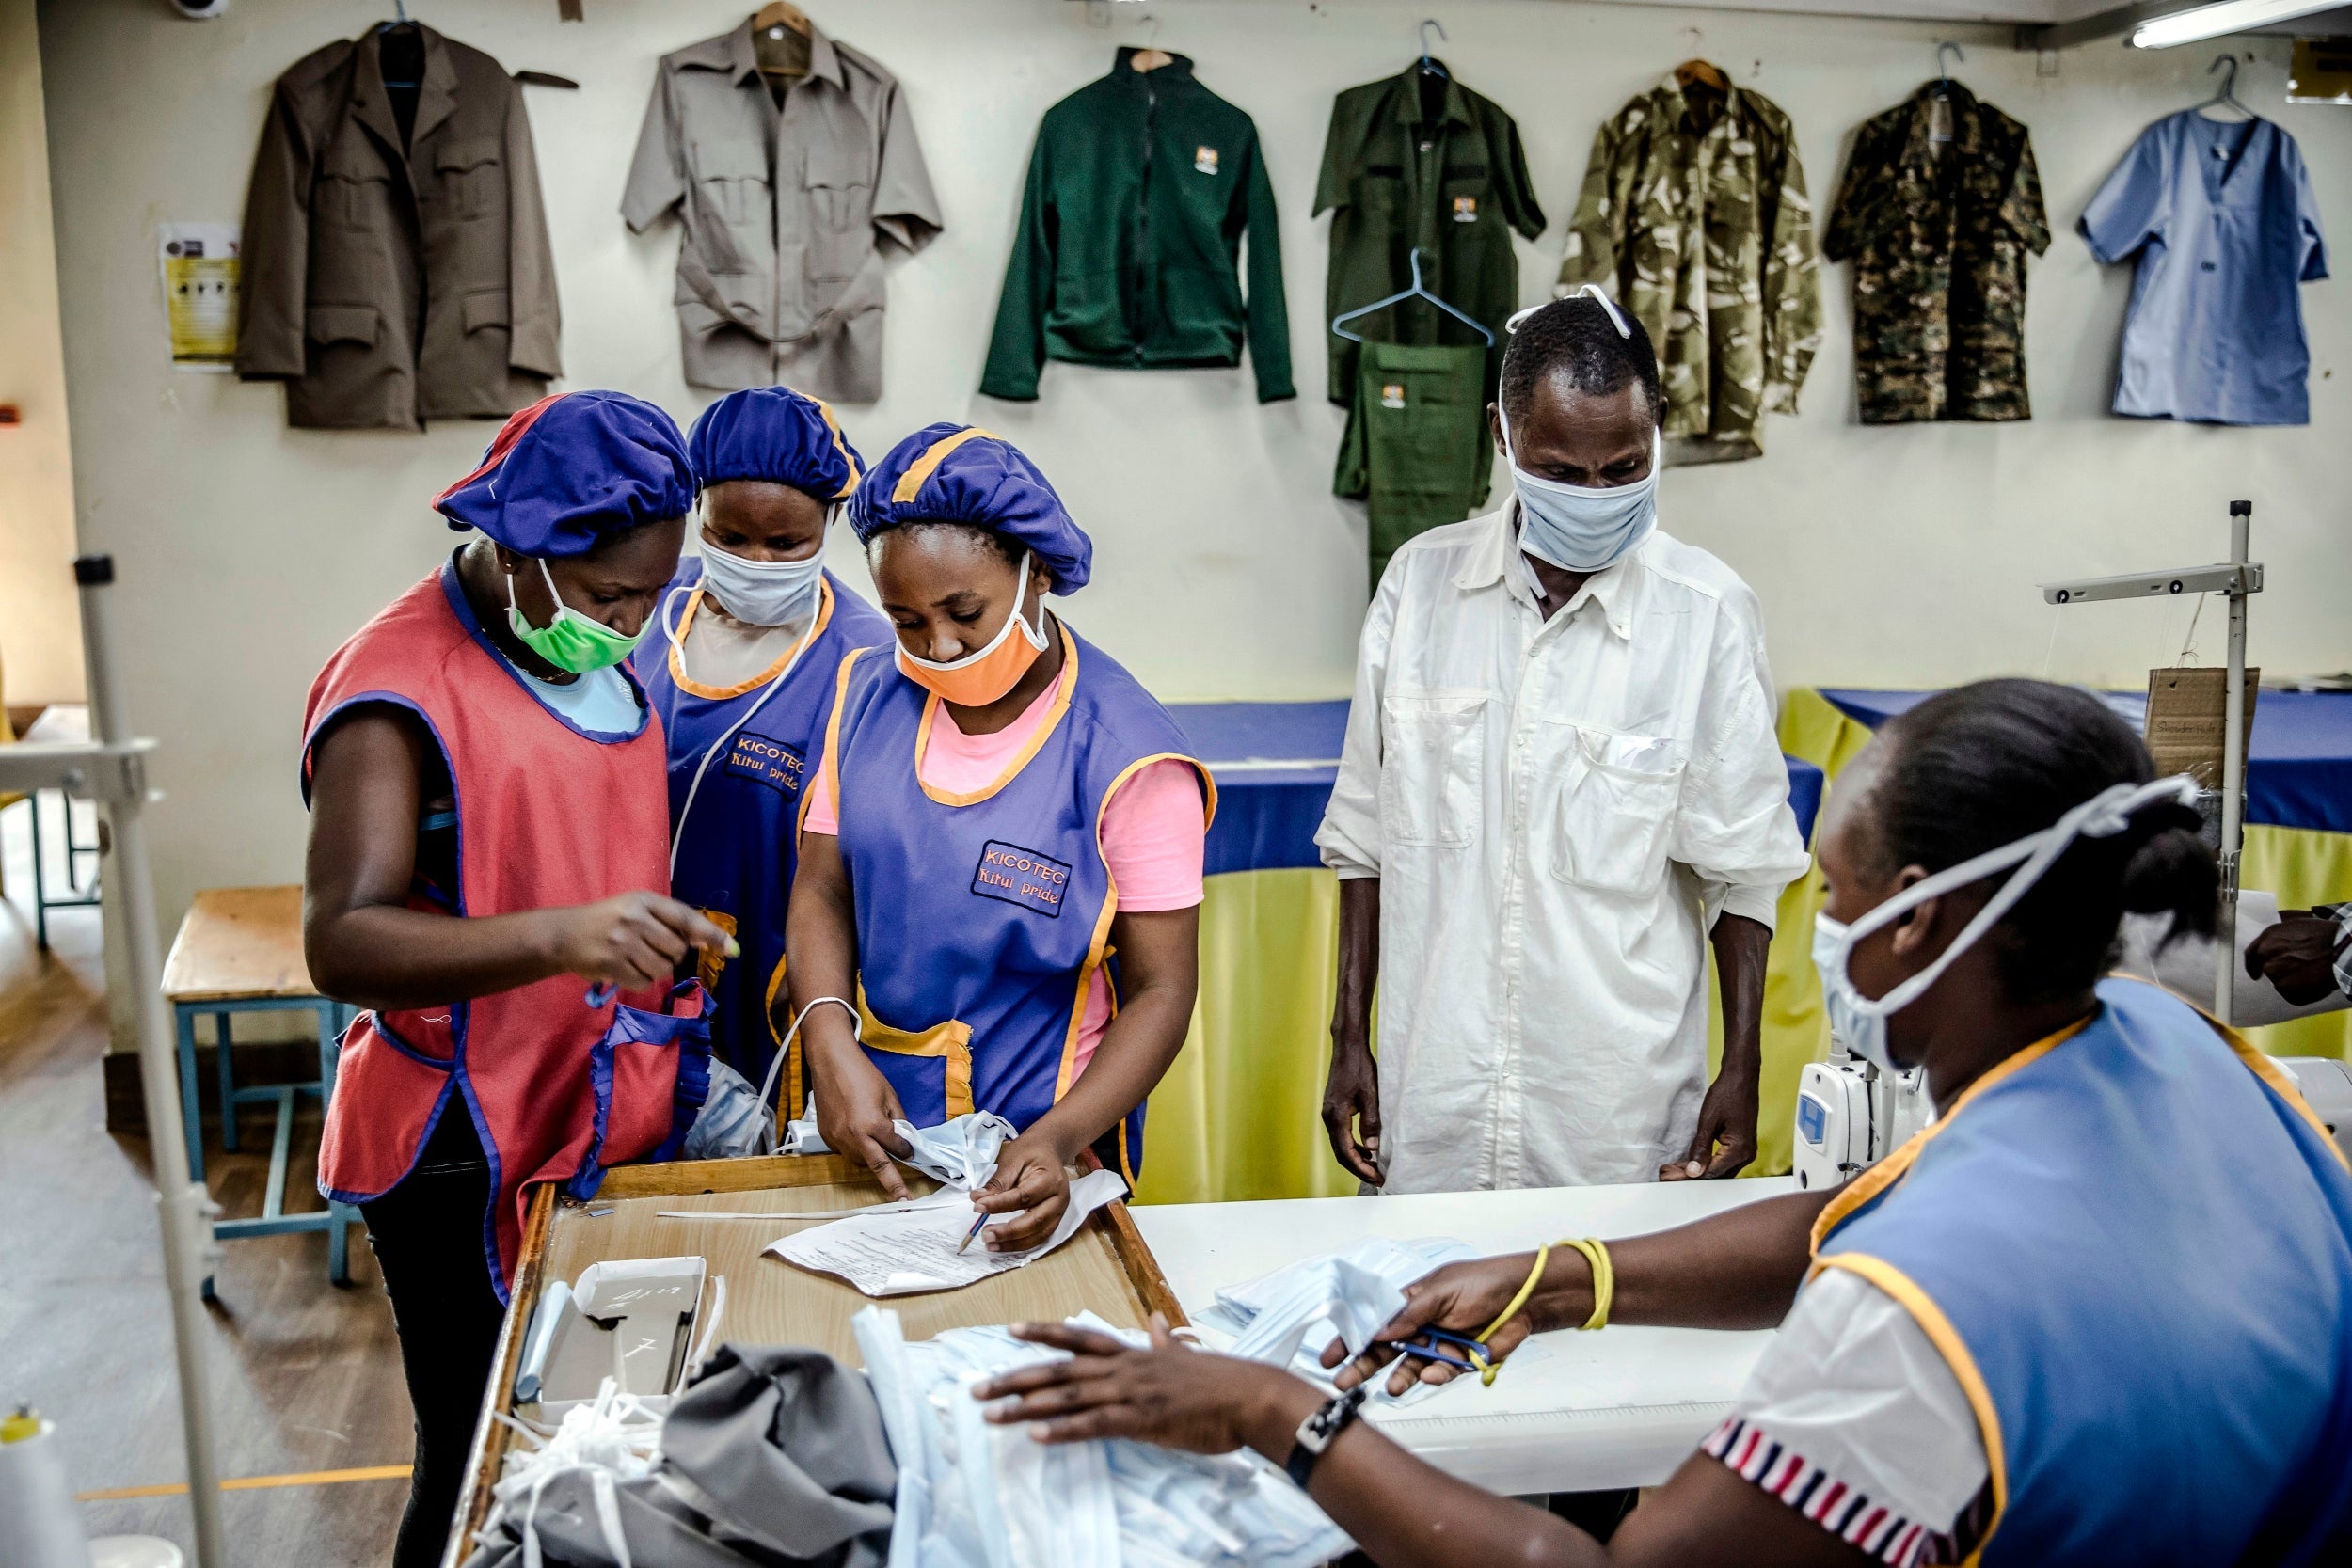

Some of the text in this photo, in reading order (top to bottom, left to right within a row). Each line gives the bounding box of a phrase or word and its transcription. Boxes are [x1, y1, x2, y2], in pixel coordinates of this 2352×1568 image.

[731, 752, 799, 790] Kitui pride
[738, 738, 805, 774] KICOTEC
[985, 849, 1065, 884] KICOTEC
[978, 867, 1059, 904] Kitui pride
